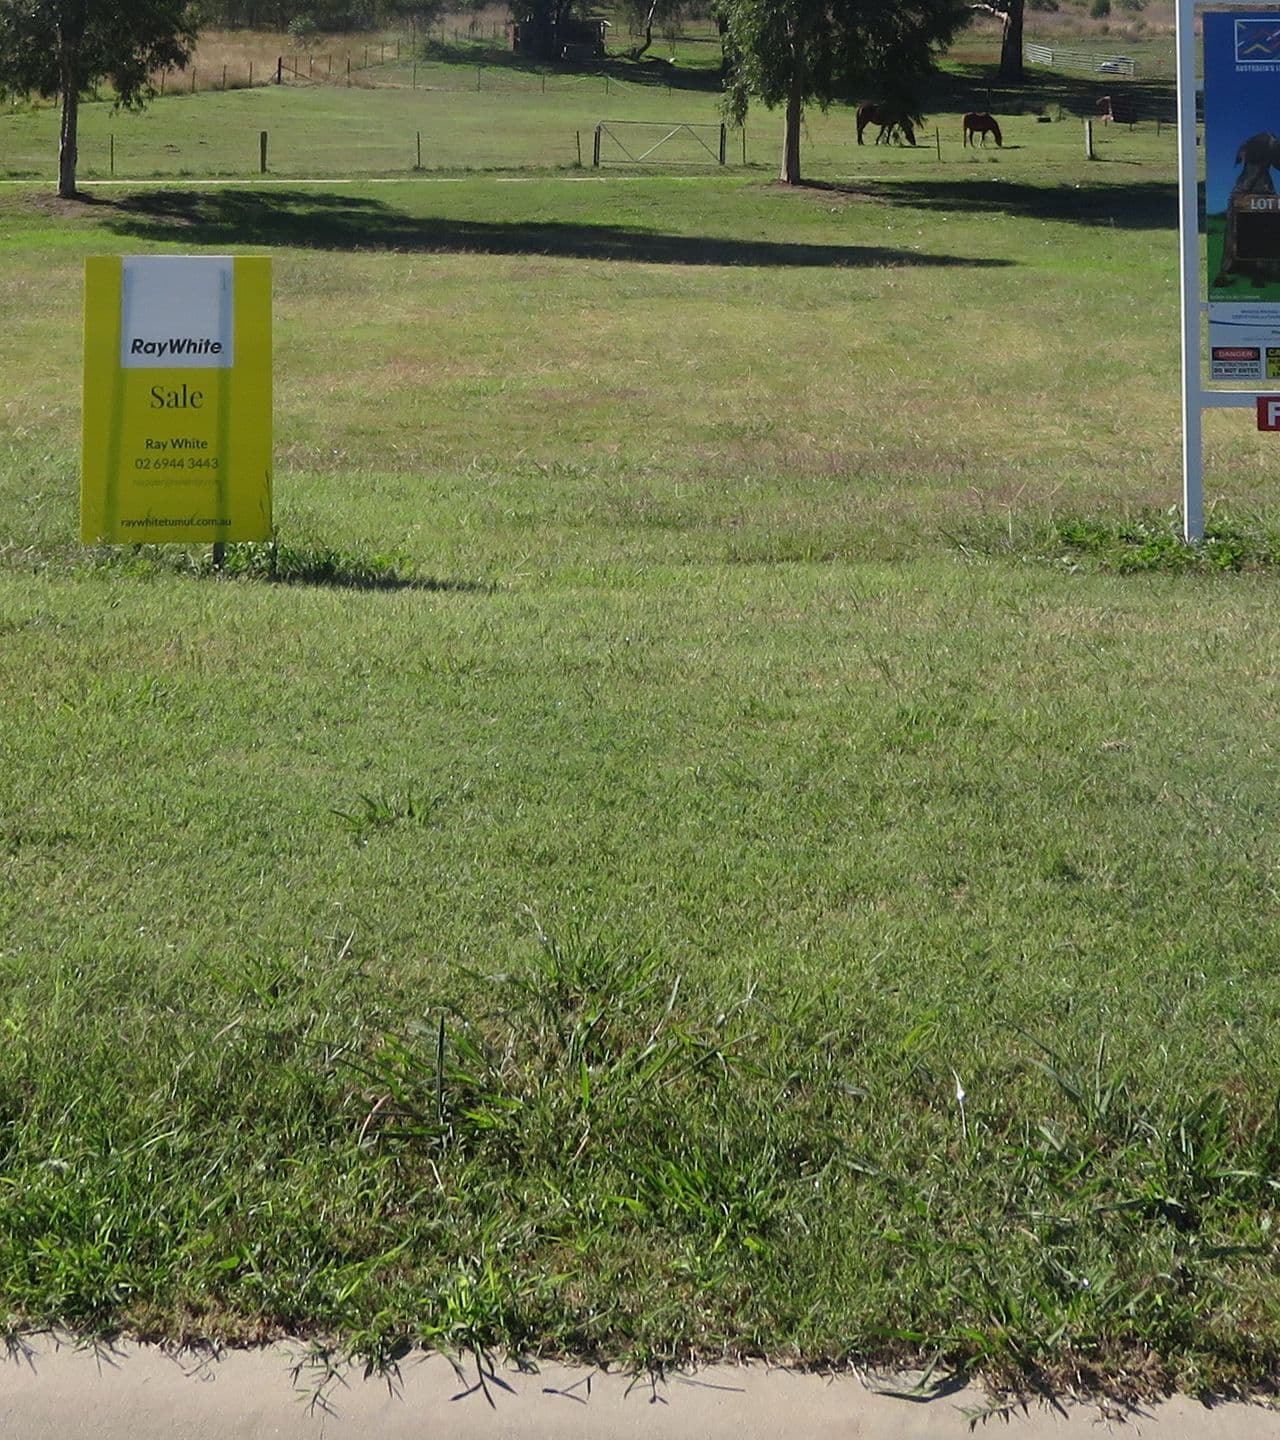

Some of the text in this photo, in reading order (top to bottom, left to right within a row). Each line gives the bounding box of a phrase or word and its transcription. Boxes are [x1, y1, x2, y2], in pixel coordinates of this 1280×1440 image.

[1251, 198, 1274, 211] LOT
[1218, 350, 1254, 358] DANGER
[150, 383, 204, 409] Sale
[145, 438, 208, 450] Ray White
[134, 458, 151, 470] 02
[153, 458, 185, 470] 6944
